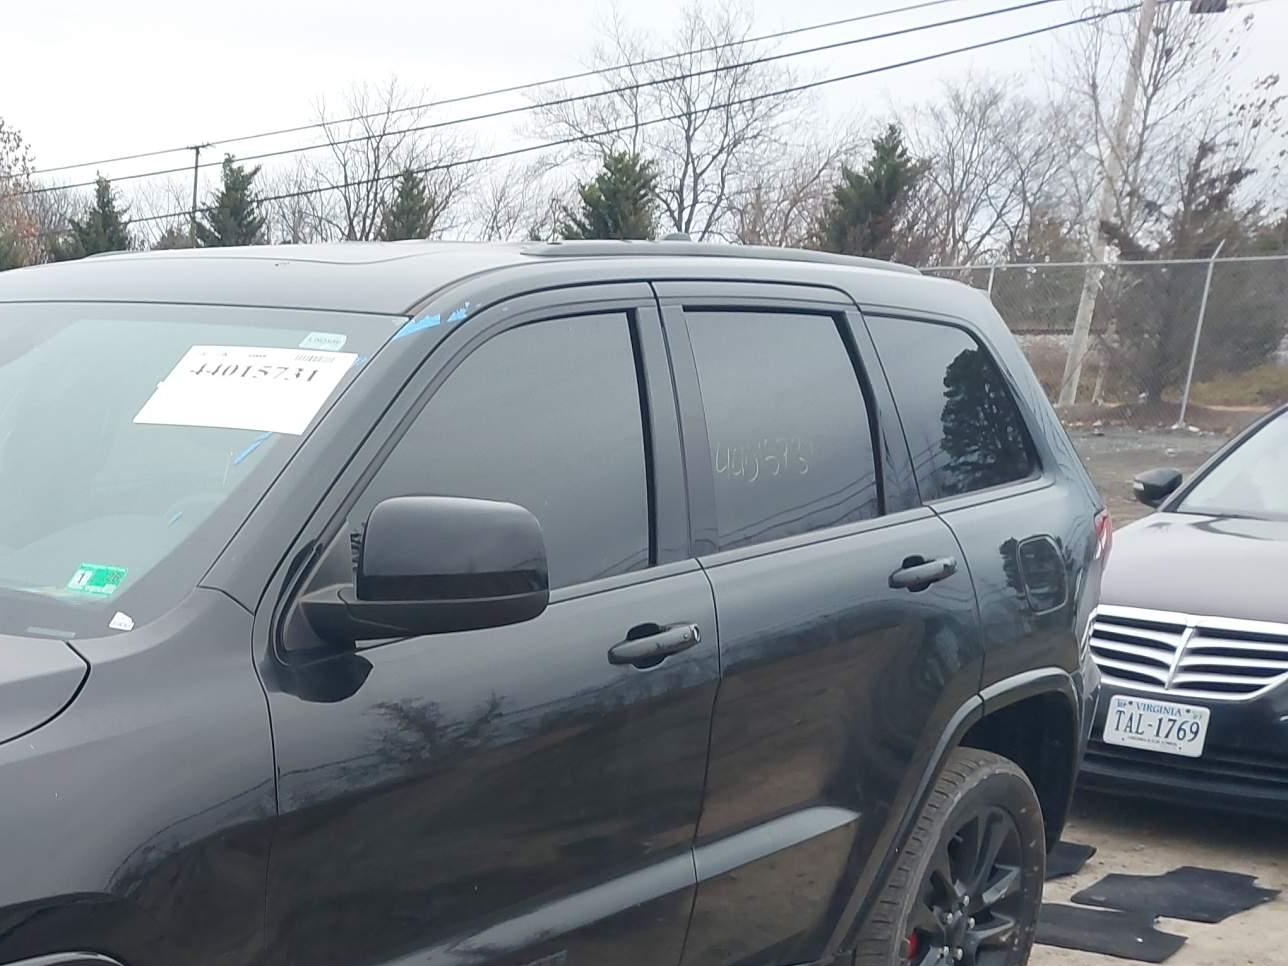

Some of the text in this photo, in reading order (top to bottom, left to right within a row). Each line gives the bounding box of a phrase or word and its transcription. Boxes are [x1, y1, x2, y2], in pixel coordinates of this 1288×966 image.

[189, 363, 320, 382] 44015731
[1136, 702, 1183, 717] VIRGINIA
[1114, 709, 1200, 743] TAL-1769
